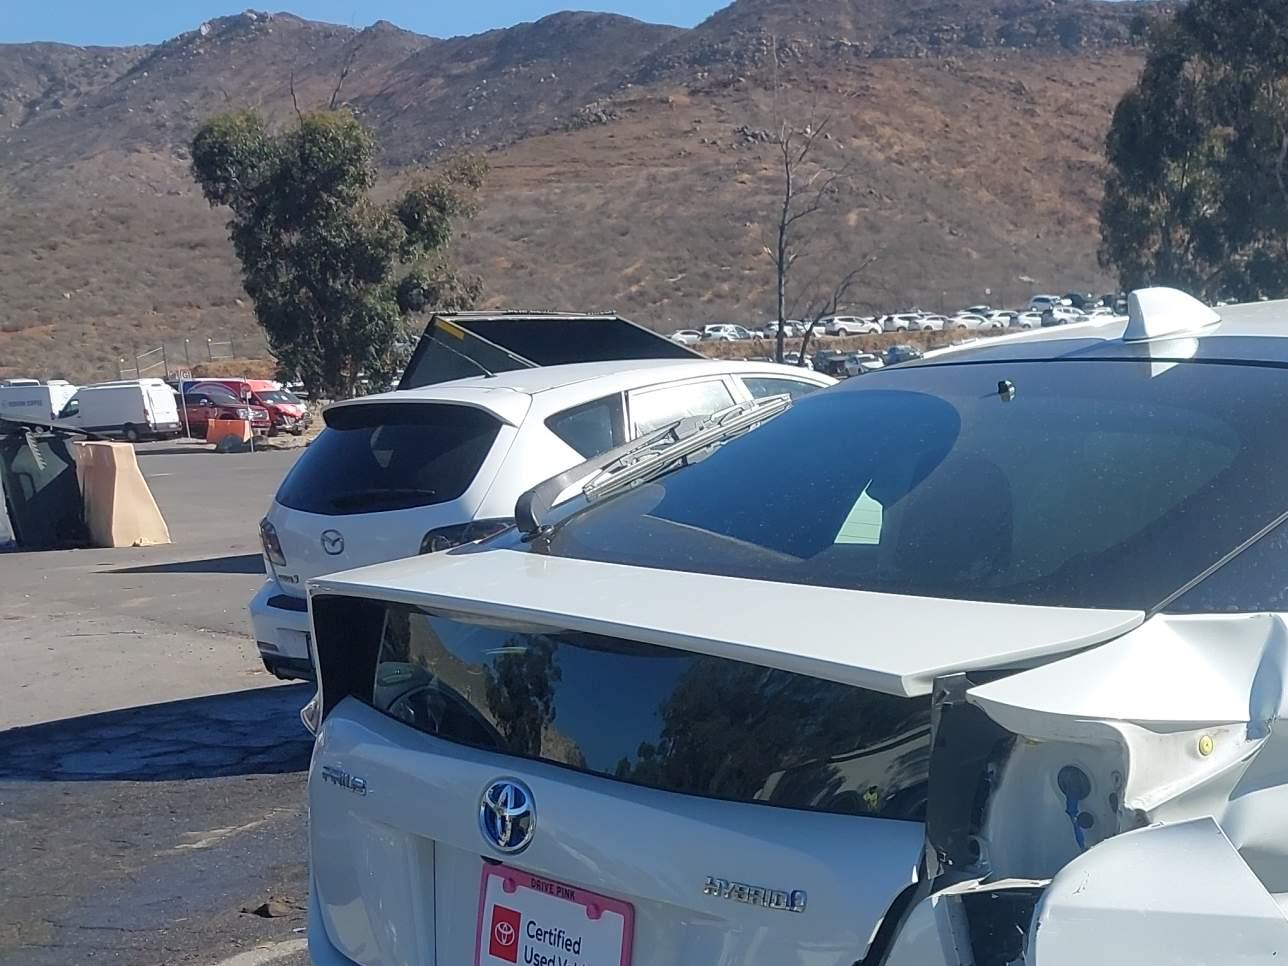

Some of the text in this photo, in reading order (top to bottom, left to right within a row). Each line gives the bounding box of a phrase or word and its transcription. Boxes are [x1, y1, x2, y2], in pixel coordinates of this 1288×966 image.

[530, 877, 576, 901] DRIVE PINK
[526, 920, 582, 955] Certified
